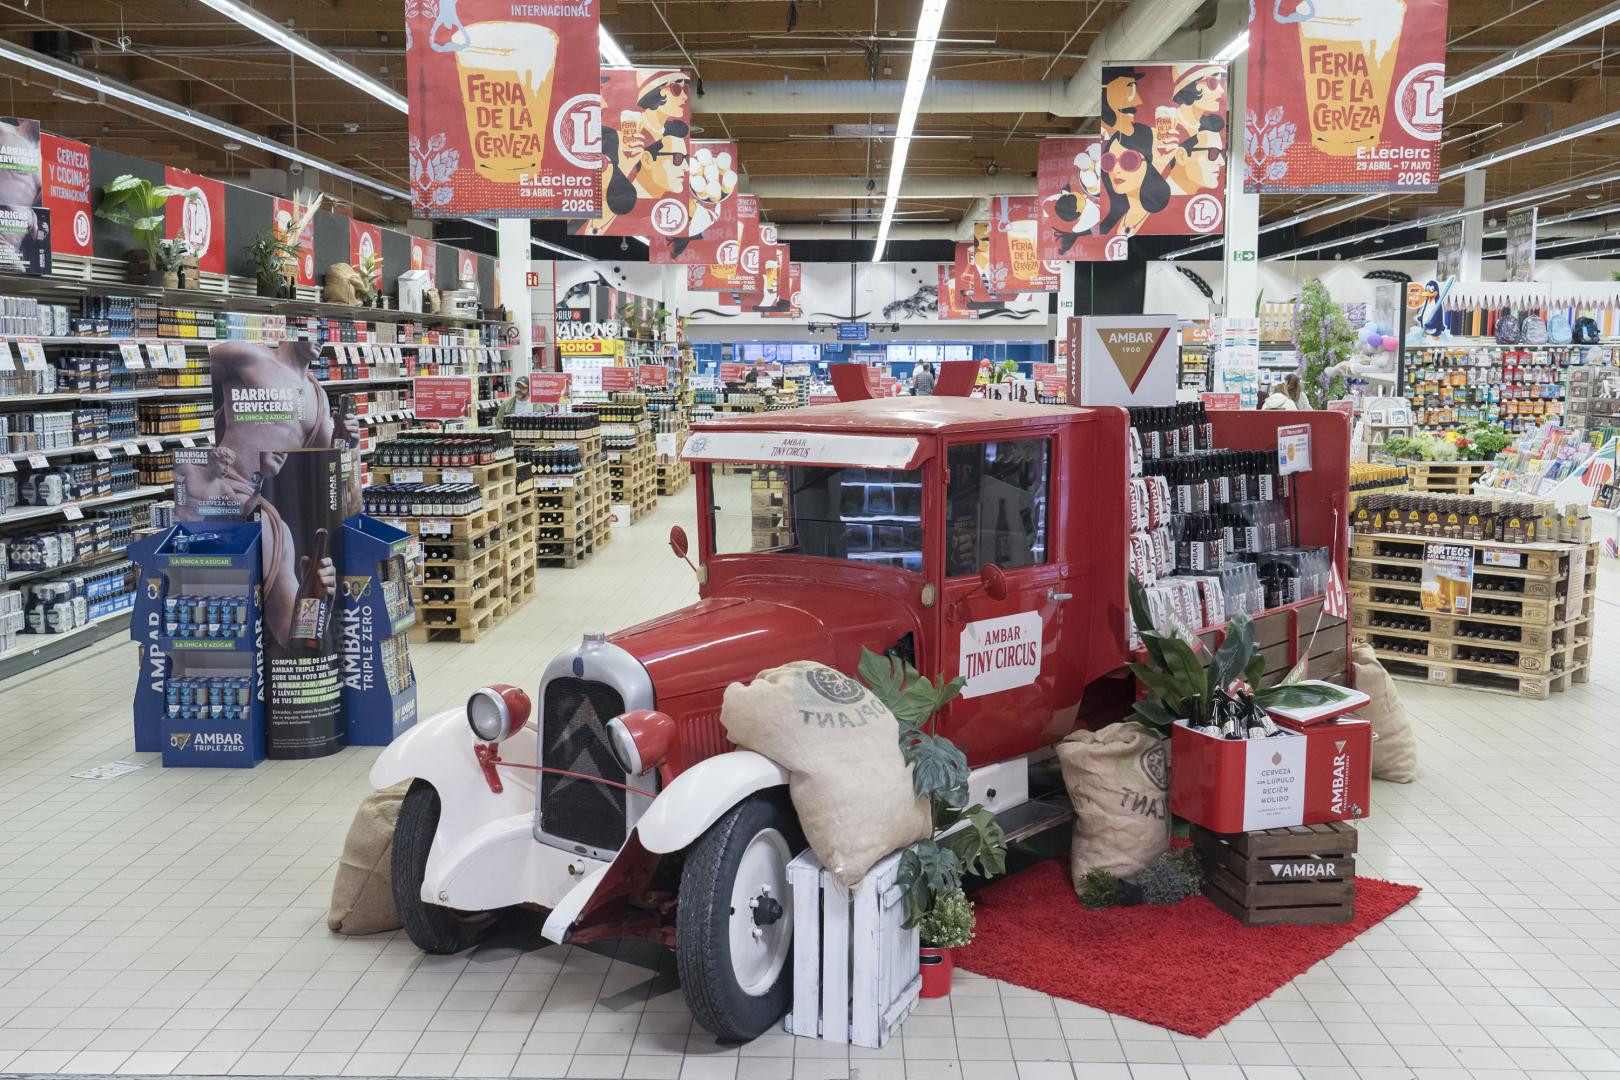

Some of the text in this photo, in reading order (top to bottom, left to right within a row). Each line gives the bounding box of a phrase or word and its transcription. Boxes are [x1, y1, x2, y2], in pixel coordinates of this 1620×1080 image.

[511, 5, 591, 17] INTERNACIONAL
[1309, 45, 1368, 77] FERIA
[467, 74, 526, 106] FERIA
[1316, 78, 1374, 102] DE LA
[476, 106, 533, 131] DE LA
[1313, 103, 1381, 131] CERVEZA
[0, 145, 38, 157] ARRIGAS
[475, 131, 541, 159] CERVEZA
[57, 147, 89, 169] CERVEZA
[1356, 146, 1430, 159] E.Leclerc
[1356, 162, 1367, 170] 29
[1368, 162, 1392, 170] ABRIL
[1400, 162, 1408, 170] 17
[1410, 162, 1431, 170] MAYO
[49, 164, 55, 181] Y
[57, 168, 83, 187] COCINA
[519, 174, 592, 186] E.Leclerc
[1397, 172, 1431, 185] 2026
[520, 189, 531, 197] 29
[532, 189, 555, 197] ABRIL
[563, 189, 571, 197] 17
[572, 189, 594, 197] MAYO
[562, 200, 594, 212] 2026
[0, 210, 28, 219] RRIGAS
[1011, 240, 1033, 251] FERIA
[1026, 252, 1035, 260] LA
[1013, 261, 1039, 271] CERVEZA
[1109, 332, 1153, 343] AMBAR
[560, 343, 596, 352] ROMO
[231, 388, 293, 401] BARRIGAS
[232, 402, 294, 412] CERVECERAS
[771, 446, 810, 458] TINY CIRCUS
[1427, 545, 1470, 557] SORTEOS
[984, 626, 1020, 646] AMBAR
[344, 605, 361, 690] AMBAR
[362, 606, 373, 691] TRIPLE ZERO
[966, 641, 1037, 680] TINY CIRCUS
[194, 733, 243, 744] AMBAR
[1261, 768, 1291, 776] CERVEZA
[1267, 776, 1295, 785] LÚPULO
[1331, 753, 1345, 814] AMBAR
[1262, 786, 1288, 795] RECIÉN
[1261, 795, 1289, 803] MOLIDO
[1282, 863, 1336, 877] AMBAR
